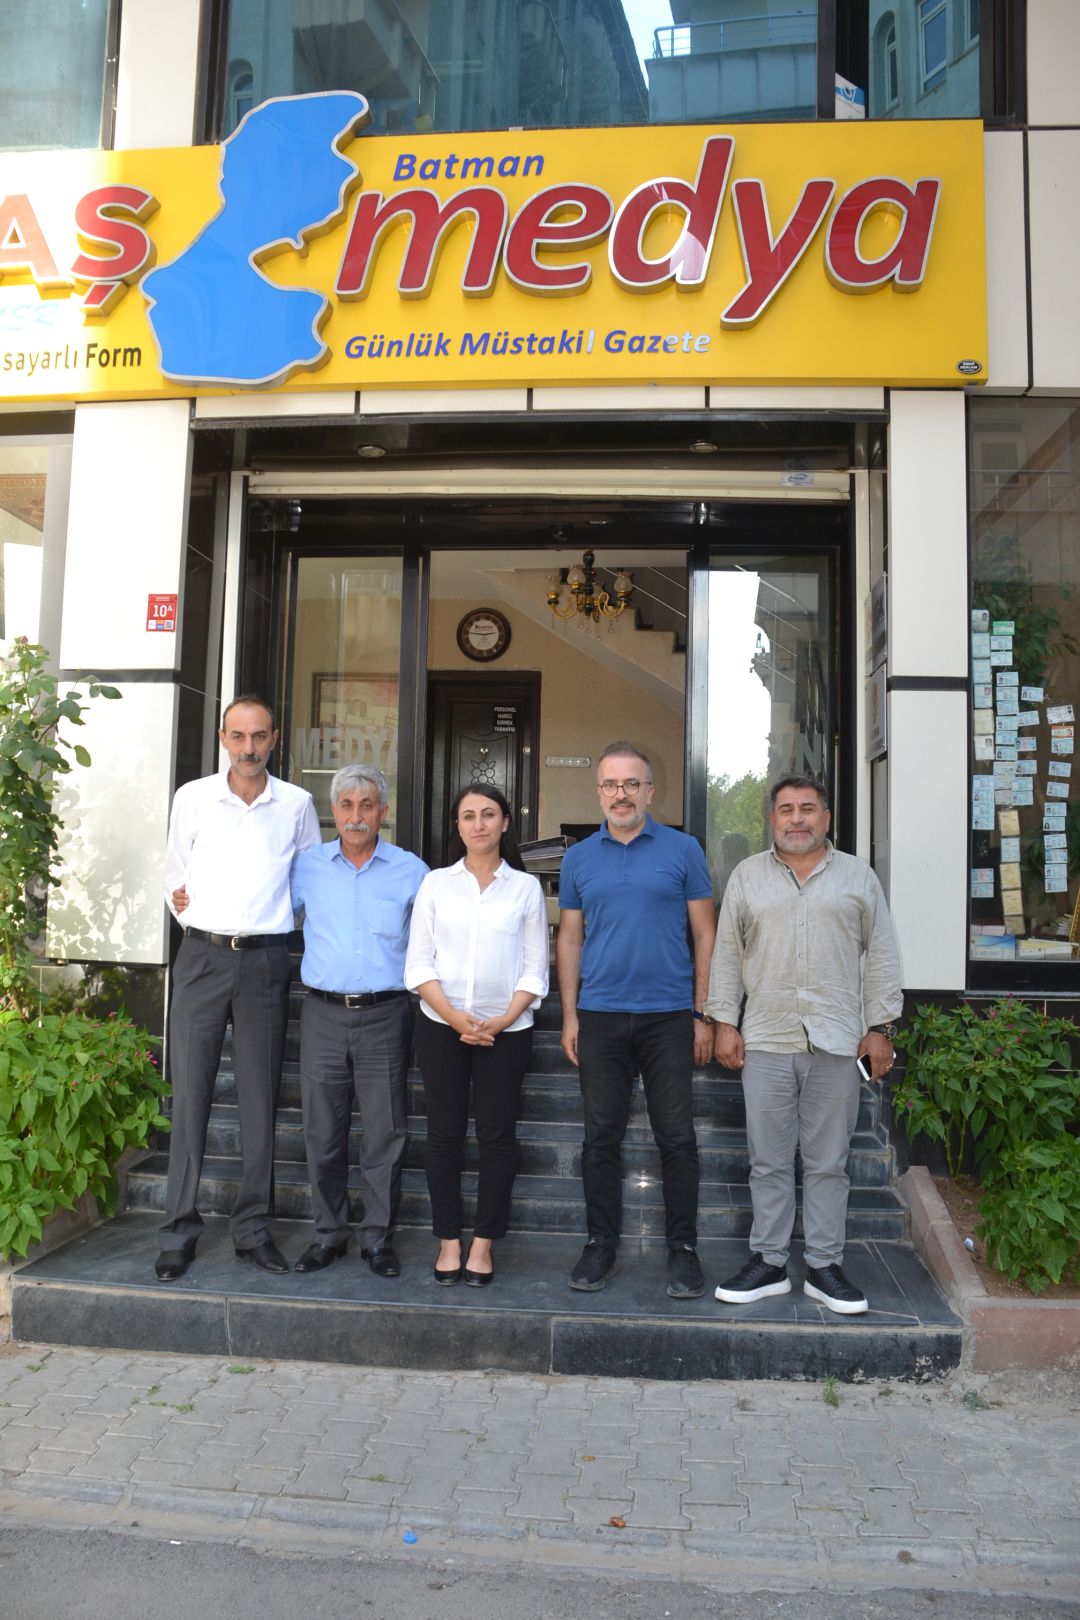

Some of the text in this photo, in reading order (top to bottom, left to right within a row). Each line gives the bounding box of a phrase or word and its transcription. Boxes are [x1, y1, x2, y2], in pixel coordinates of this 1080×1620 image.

[393, 154, 545, 181] Batman
[334, 134, 942, 326] medya
[86, 343, 141, 368] Form
[345, 329, 712, 359] Günlük Müstakil Gazete
